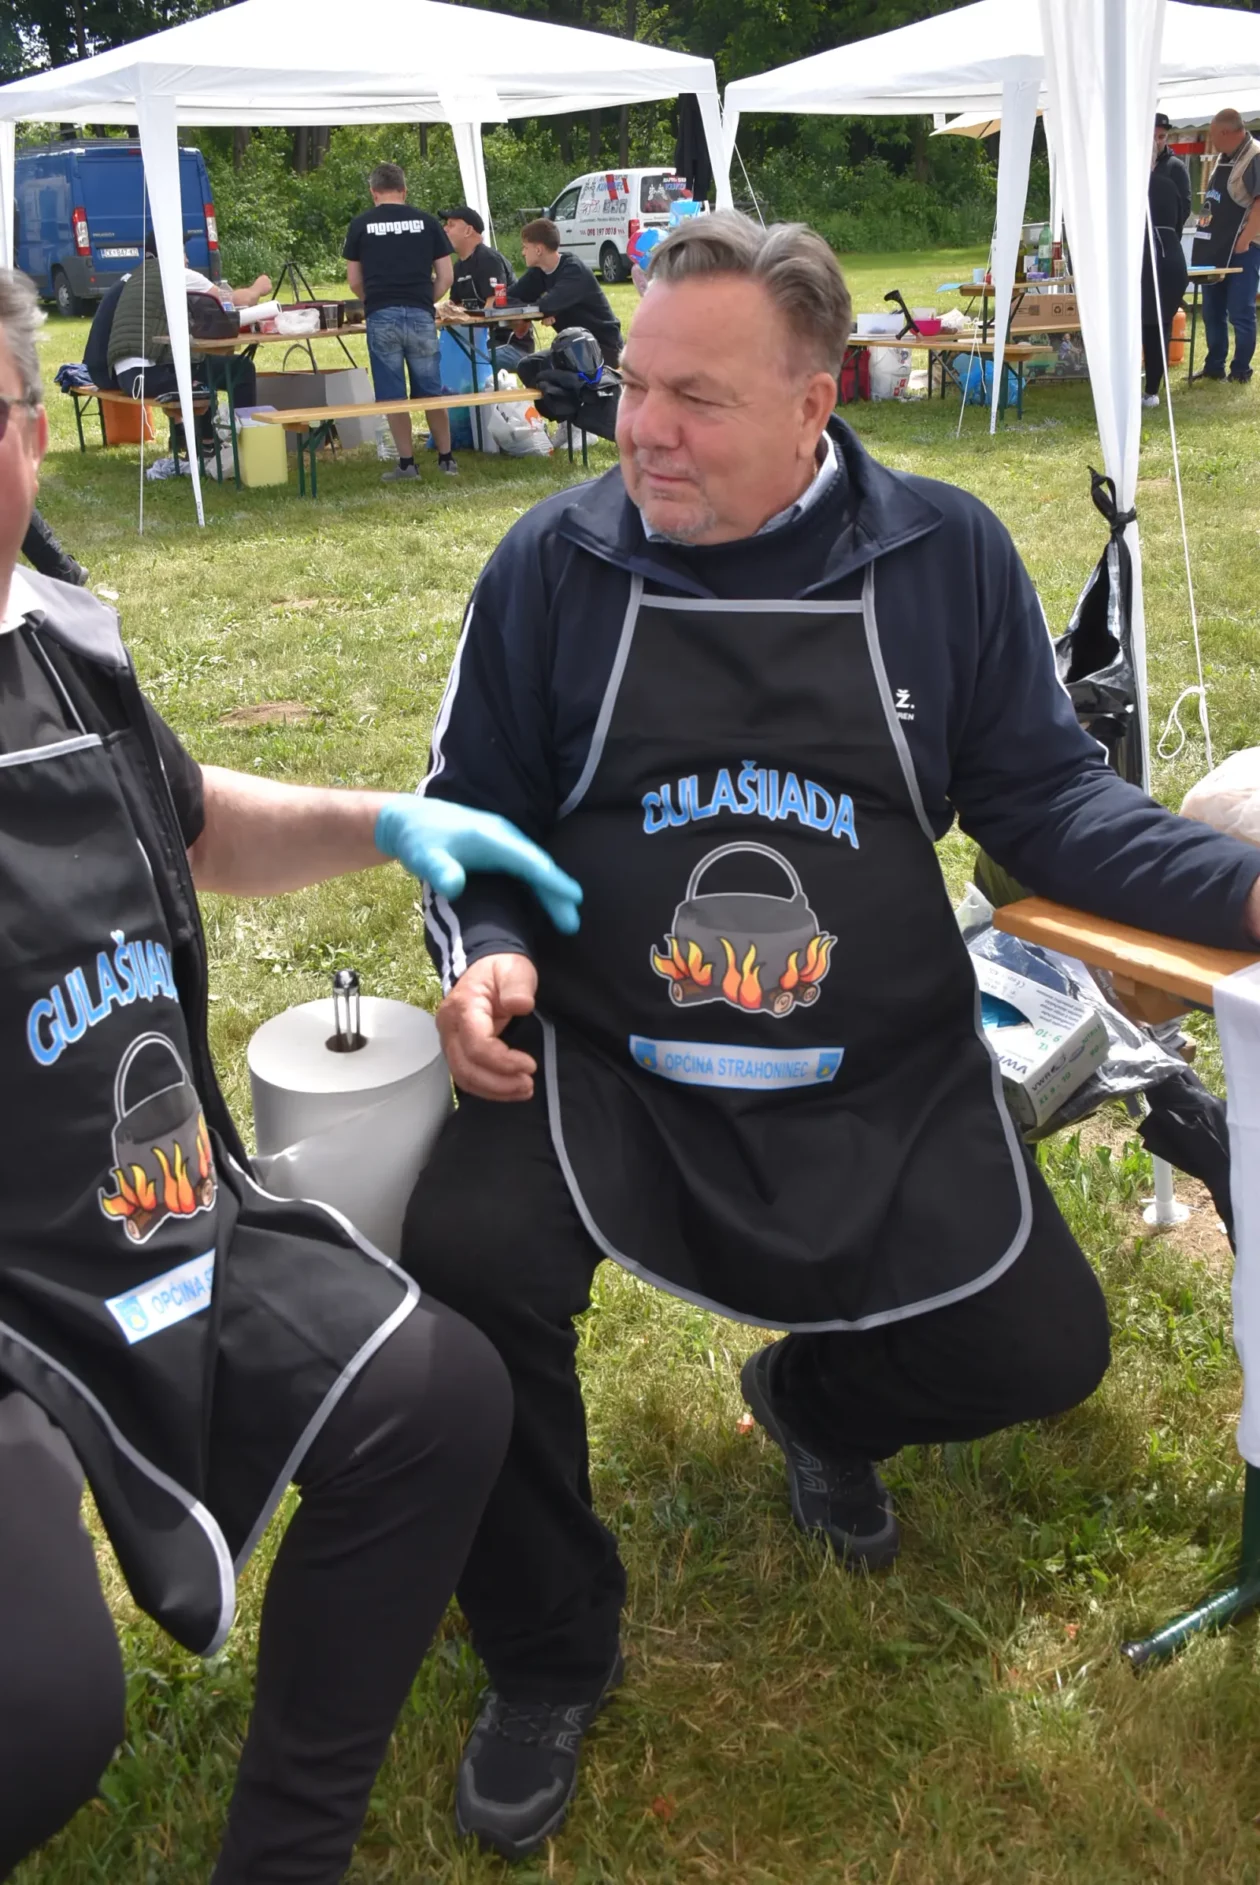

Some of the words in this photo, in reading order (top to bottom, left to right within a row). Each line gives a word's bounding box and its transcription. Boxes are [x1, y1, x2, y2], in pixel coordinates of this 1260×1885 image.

[26, 929, 179, 1066] GULAŠIJAD
[717, 1056, 809, 1080] STRAHONINEC
[1031, 1073, 1052, 1091] VWR
